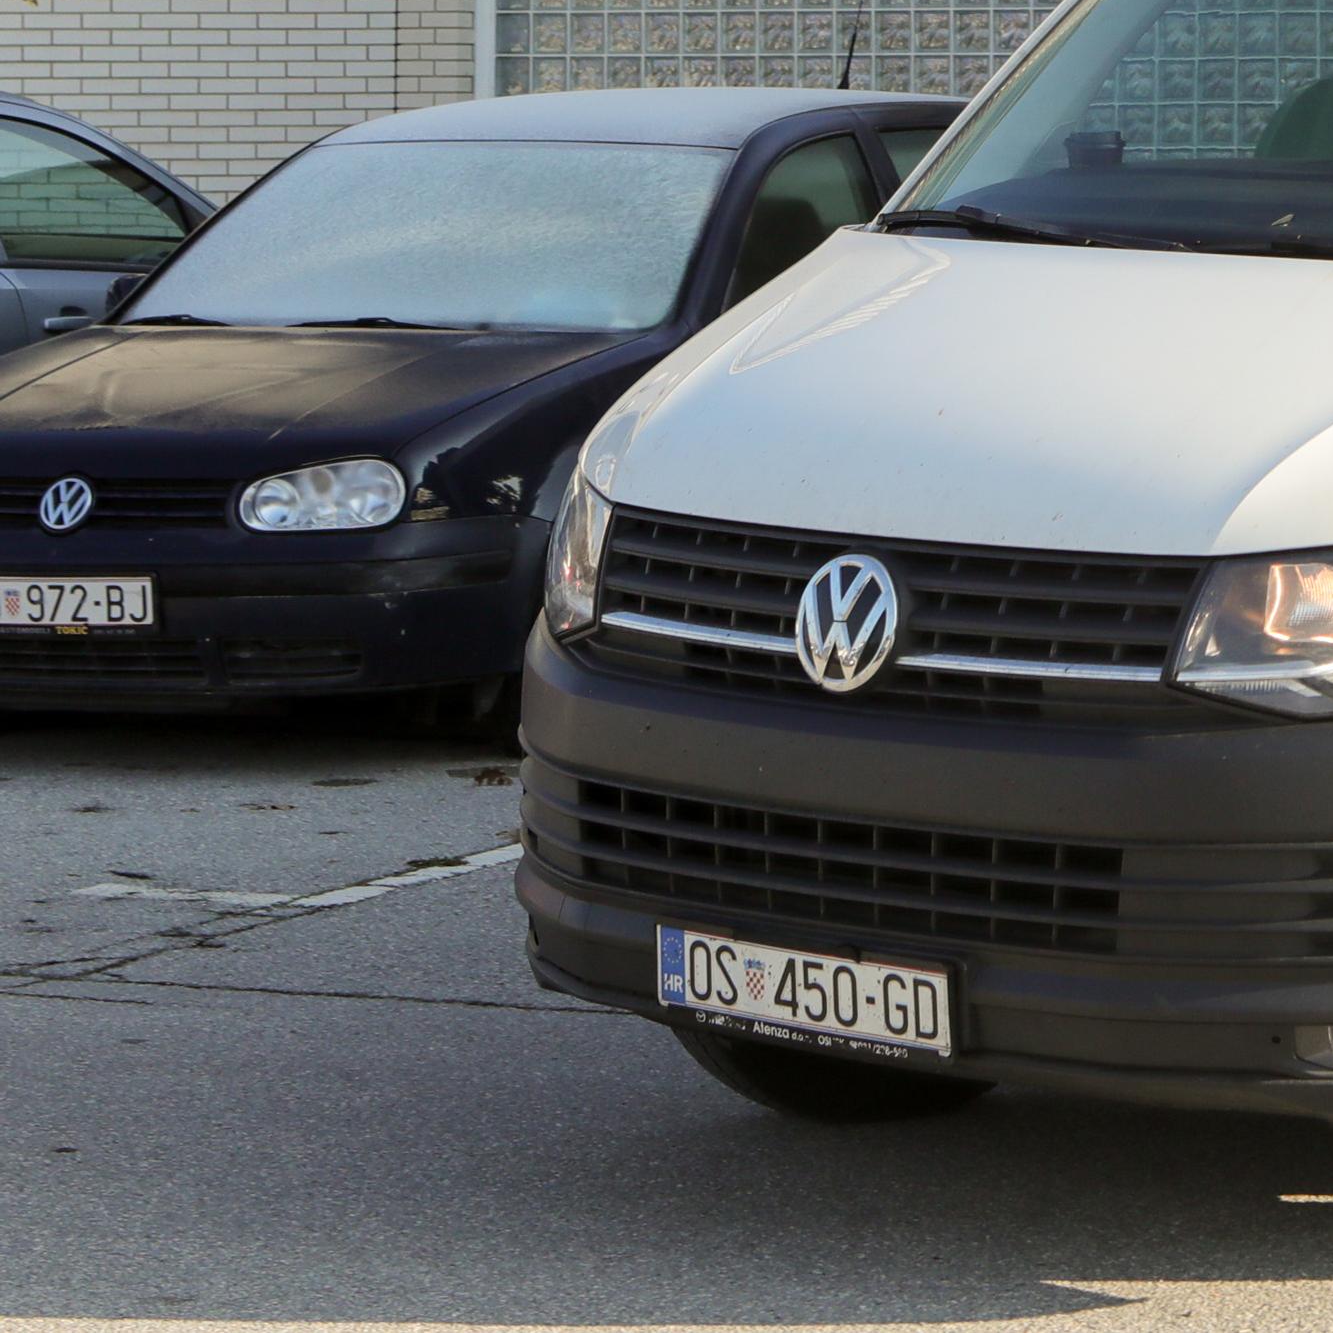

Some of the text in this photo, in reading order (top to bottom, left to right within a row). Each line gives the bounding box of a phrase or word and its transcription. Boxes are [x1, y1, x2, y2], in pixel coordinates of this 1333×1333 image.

[26, 584, 147, 622] 972-BJ
[795, 554, 898, 692] VW
[664, 973, 683, 994] HR
[774, 958, 939, 1040] 450-GD
